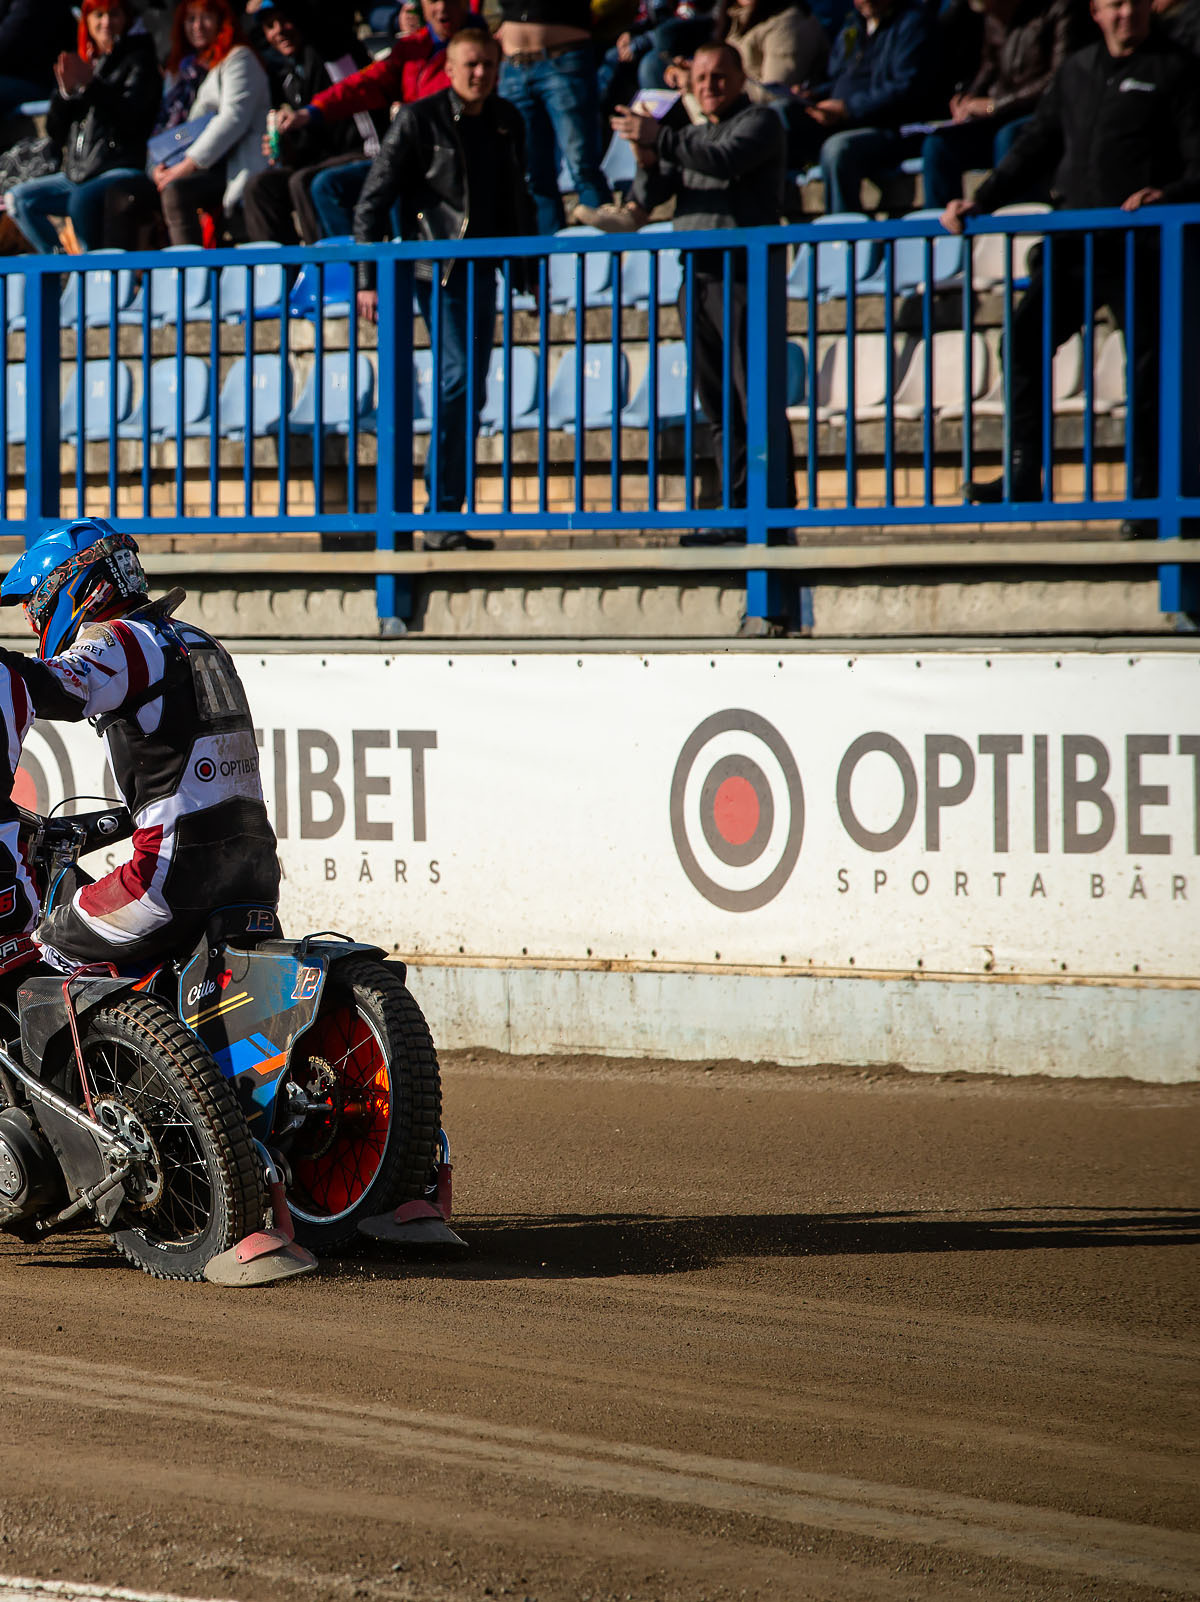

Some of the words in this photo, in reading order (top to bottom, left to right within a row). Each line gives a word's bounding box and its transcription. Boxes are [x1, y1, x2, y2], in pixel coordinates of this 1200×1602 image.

[194, 654, 238, 713] 11
[219, 757, 259, 777] OPTIBET
[255, 728, 437, 842] IBET
[325, 852, 442, 884] BĀRS
[837, 868, 1047, 898] SPORTA
[1090, 866, 1188, 901] BĀR
[245, 909, 275, 932] 12
[187, 980, 216, 1006] Cille
[290, 966, 322, 1000] 12
